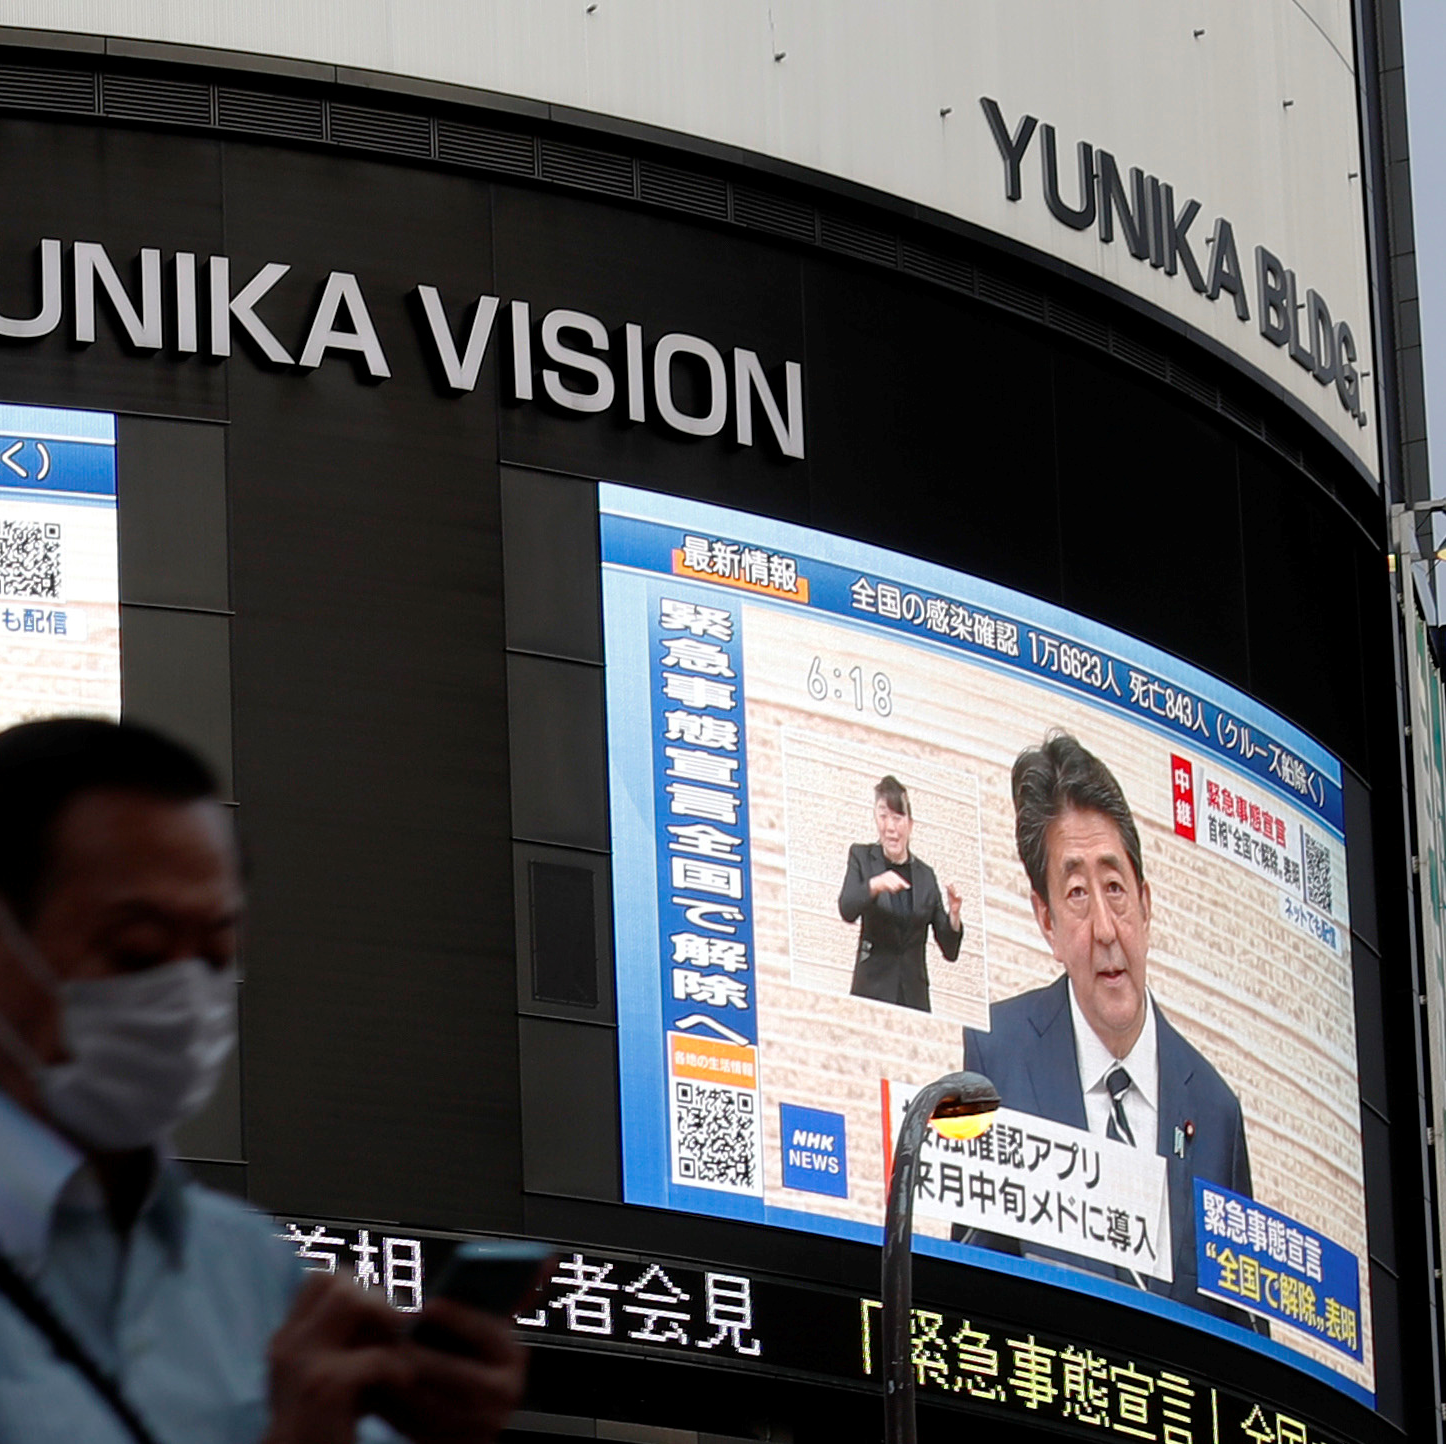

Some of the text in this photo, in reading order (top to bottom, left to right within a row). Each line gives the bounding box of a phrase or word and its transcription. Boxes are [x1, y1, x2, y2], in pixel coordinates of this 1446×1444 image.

[979, 97, 1367, 428] YUNIKA BLDG.
[417, 284, 804, 460] VISION
[683, 534, 797, 594] 最新情報
[851, 576, 1019, 656] 全国の感染確認
[1028, 632, 1121, 697] 1万6623人
[807, 655, 892, 717] 6:18
[660, 597, 750, 1047] 緊急事態宣言全国で解除へ
[1174, 769, 1193, 828] 中継
[1206, 780, 1287, 849] 緊急事態宣言
[674, 1049, 754, 1078] 各地の生活情報
[789, 1149, 839, 1174] NEWS
[792, 1129, 835, 1152] NHK
[903, 1100, 1100, 1190] 確認アプリ
[914, 1160, 1157, 1263] 来月中旬メドに導入
[1203, 1188, 1323, 1283] 緊急事態宣言
[514, 1253, 761, 1356] 者会見
